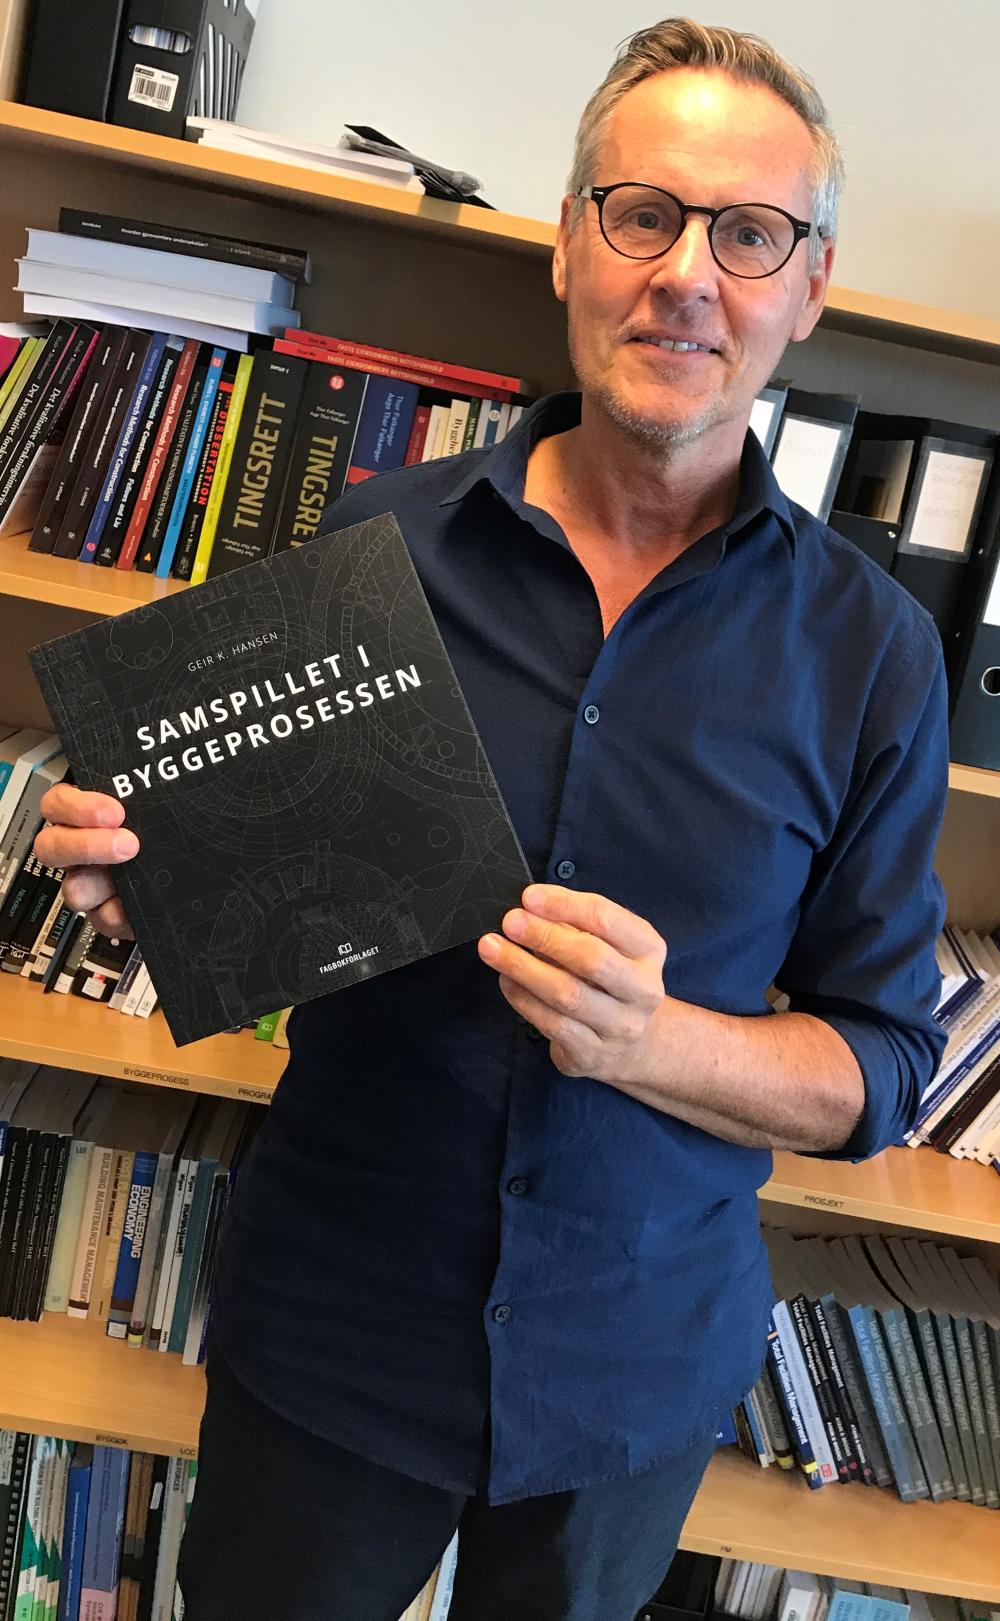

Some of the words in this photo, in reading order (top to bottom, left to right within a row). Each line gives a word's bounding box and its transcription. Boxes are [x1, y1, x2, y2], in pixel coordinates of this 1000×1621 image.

[156, 358, 173, 389] Research
[26, 382, 39, 399] Det
[47, 387, 61, 404] Det
[131, 383, 148, 416] Research
[147, 389, 163, 419] Methods
[167, 383, 183, 415] Research
[383, 392, 394, 410] Aage
[394, 395, 403, 411] Thor
[8, 397, 32, 437] kvalitative
[28, 402, 54, 441] kvalitative
[121, 415, 138, 447] Methods
[144, 419, 154, 430] for
[158, 414, 173, 446] Methods
[175, 408, 191, 448] KVALITATIVE
[206, 401, 220, 442] ARCHITECTURE
[381, 411, 390, 427] Thor
[384, 411, 399, 446] Falkanger
[117, 446, 128, 458] for
[130, 430, 150, 473] Construction
[154, 446, 163, 457] for
[197, 410, 228, 505] DISSERTATION
[199, 443, 210, 472] STUDENT'S
[233, 392, 286, 528] TINGSRETT
[372, 428, 386, 462] Falkanger
[103, 457, 124, 502] Construction
[121, 477, 135, 502] Fellows
[141, 457, 160, 500] Construction
[290, 436, 338, 548] TINGSRE
[112, 516, 123, 528] Liu
[116, 503, 127, 516] and
[188, 656, 214, 672] GEIR
[218, 651, 229, 662] K.
[232, 632, 278, 655] HANSEN
[137, 654, 341, 750] SAMSPILLET
[357, 645, 370, 668] I
[112, 664, 421, 798] BYGGEPROSESSEN
[9, 890, 26, 917] Nicholson
[30, 894, 47, 922] Nicholson
[48, 898, 61, 920] PRACTICE
[43, 922, 51, 932] AND
[53, 910, 70, 941] EMMITT
[320, 946, 379, 974] FAGBOKFORLAGET
[123, 1067, 189, 1086] BYGGEPROSESS
[97, 1152, 111, 1190] BUILDING
[124, 1185, 142, 1241] ECONOMY
[804, 1194, 844, 1208] PROSJEKT
[87, 1190, 105, 1247] MAINTENANCE
[131, 1186, 151, 1259] ENGINEERING
[790, 1301, 801, 1319] Total
[813, 1304, 824, 1321] Total
[795, 1318, 809, 1346] Facilities
[797, 1297, 807, 1313] Total
[802, 1313, 816, 1341] Facilities
[811, 1341, 828, 1380] Management
[818, 1320, 832, 1348] Facilities
[854, 1319, 868, 1340] Total
[867, 1320, 880, 1339] Total
[922, 1322, 933, 1342] Total
[940, 1326, 953, 1345] Total
[959, 1328, 971, 1348] Total
[770, 1339, 783, 1360] Total
[859, 1339, 877, 1373] Facilities
[872, 1338, 890, 1372] Facilities
[926, 1342, 940, 1375] Facilities
[944, 1345, 959, 1378] Facilities
[962, 1348, 977, 1381] Facilities
[775, 1359, 793, 1392] Facilities
[803, 1346, 821, 1386] Management
[826, 1348, 844, 1388] Management
[887, 1322, 899, 1342] Total
[893, 1342, 908, 1375] Facilities
[901, 1374, 922, 1427] Management
[868, 1372, 892, 1426] Management
[881, 1371, 905, 1424] Management
[932, 1375, 951, 1428] Management
[950, 1378, 969, 1431] Management
[968, 1381, 987, 1434] Management
[784, 1392, 809, 1444] Management
[180, 1448, 195, 1456] LCC
[173, 1470, 182, 1491] FORCES
